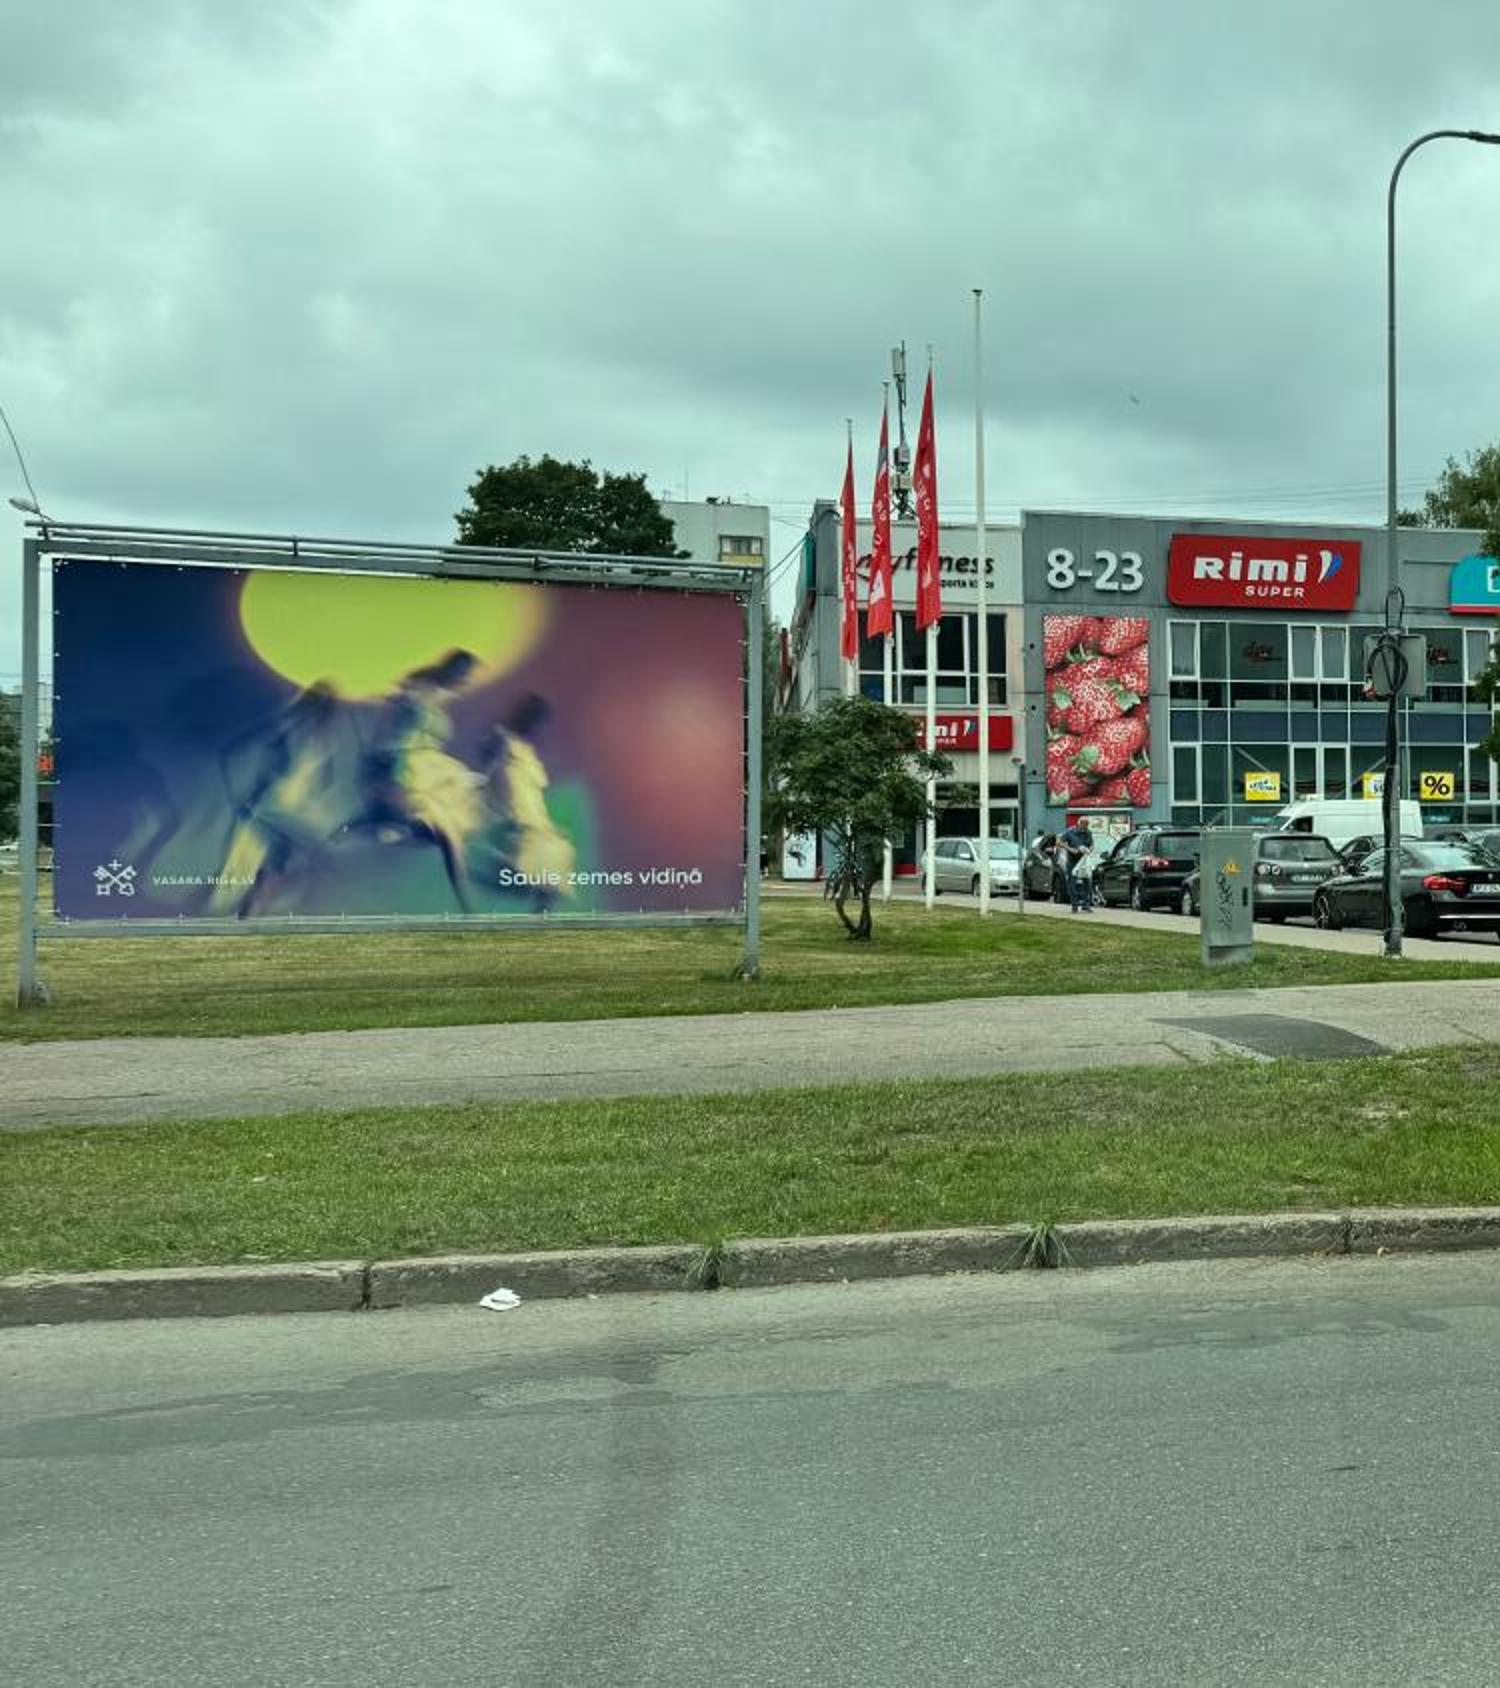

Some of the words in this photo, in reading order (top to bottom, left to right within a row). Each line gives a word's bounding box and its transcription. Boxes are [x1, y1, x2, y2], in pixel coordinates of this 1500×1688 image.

[1047, 547, 1144, 591] 8-23
[1193, 551, 1308, 583] Rimi
[1244, 585, 1305, 598] SUPER
[498, 868, 561, 886] Saule
[566, 870, 633, 886] zemes
[638, 867, 704, 889] vidiņā
